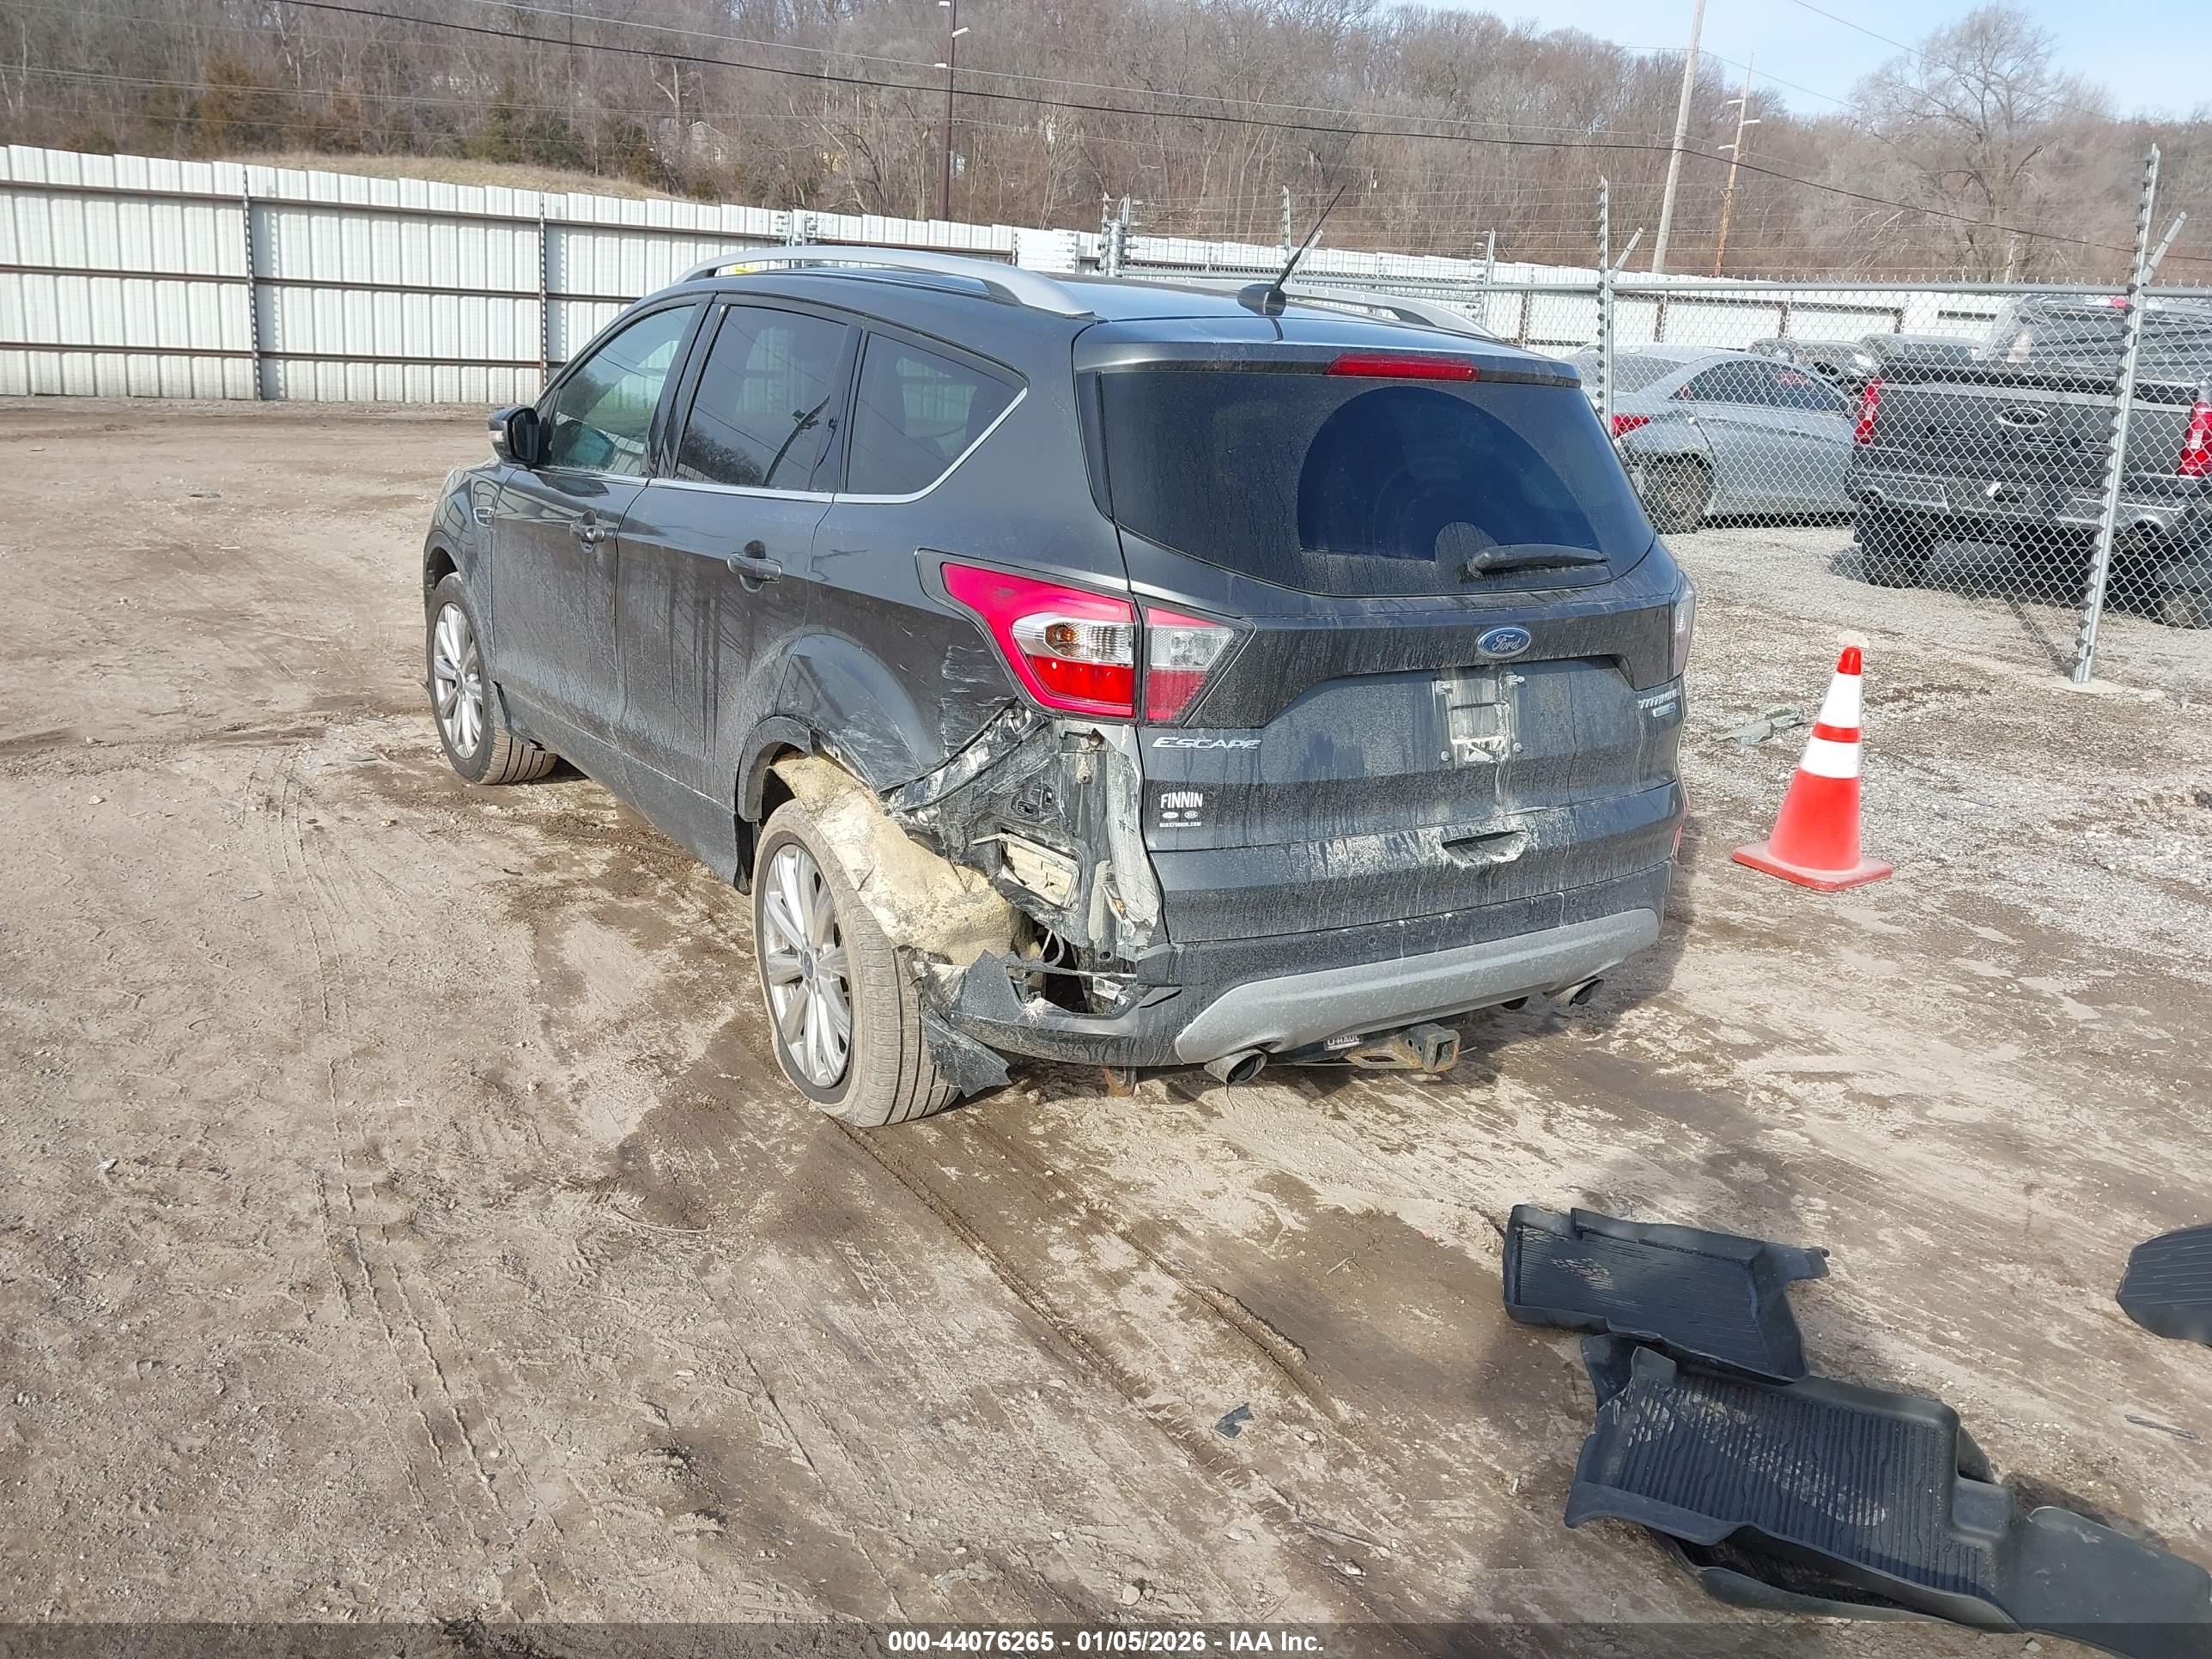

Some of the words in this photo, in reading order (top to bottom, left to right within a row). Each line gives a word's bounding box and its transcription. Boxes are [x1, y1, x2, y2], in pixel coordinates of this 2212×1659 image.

[1492, 634, 1522, 651] Ford
[1152, 737, 1261, 750] ESCAPE
[1160, 791, 1203, 809] FINNIN
[1327, 1035, 1360, 1046] U-HAUL
